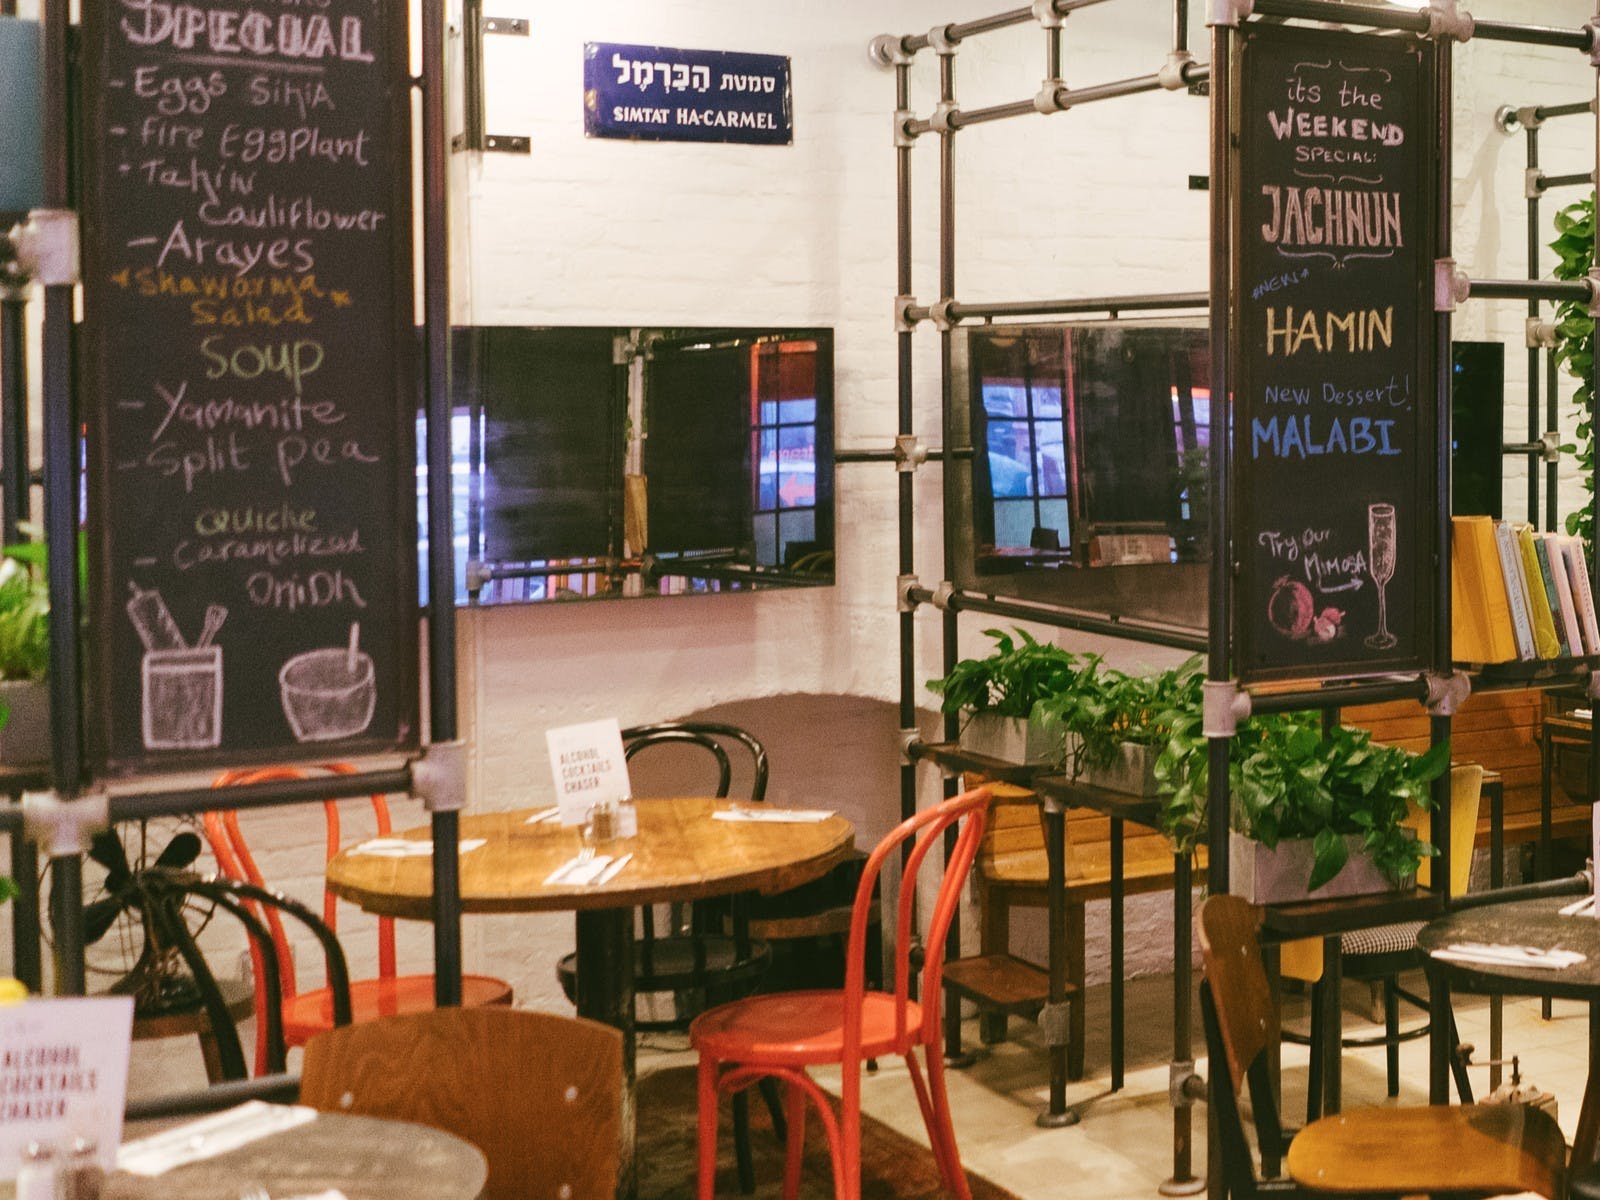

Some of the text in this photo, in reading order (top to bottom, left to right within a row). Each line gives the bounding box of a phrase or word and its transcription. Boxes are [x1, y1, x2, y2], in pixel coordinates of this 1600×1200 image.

[134, 65, 228, 115] Eggs
[720, 73, 775, 93] סמטת
[1338, 80, 1384, 109] the
[613, 106, 777, 130] SIMTAT HA-CARMEL
[1267, 106, 1405, 146] WEEKEND
[199, 193, 385, 232] Cauliflower
[1261, 184, 1404, 248] JACHNUN
[1266, 304, 1393, 356] HAMIN
[199, 334, 324, 394] Soup
[1251, 414, 1402, 460] MALABI
[1258, 531, 1299, 561] Try
